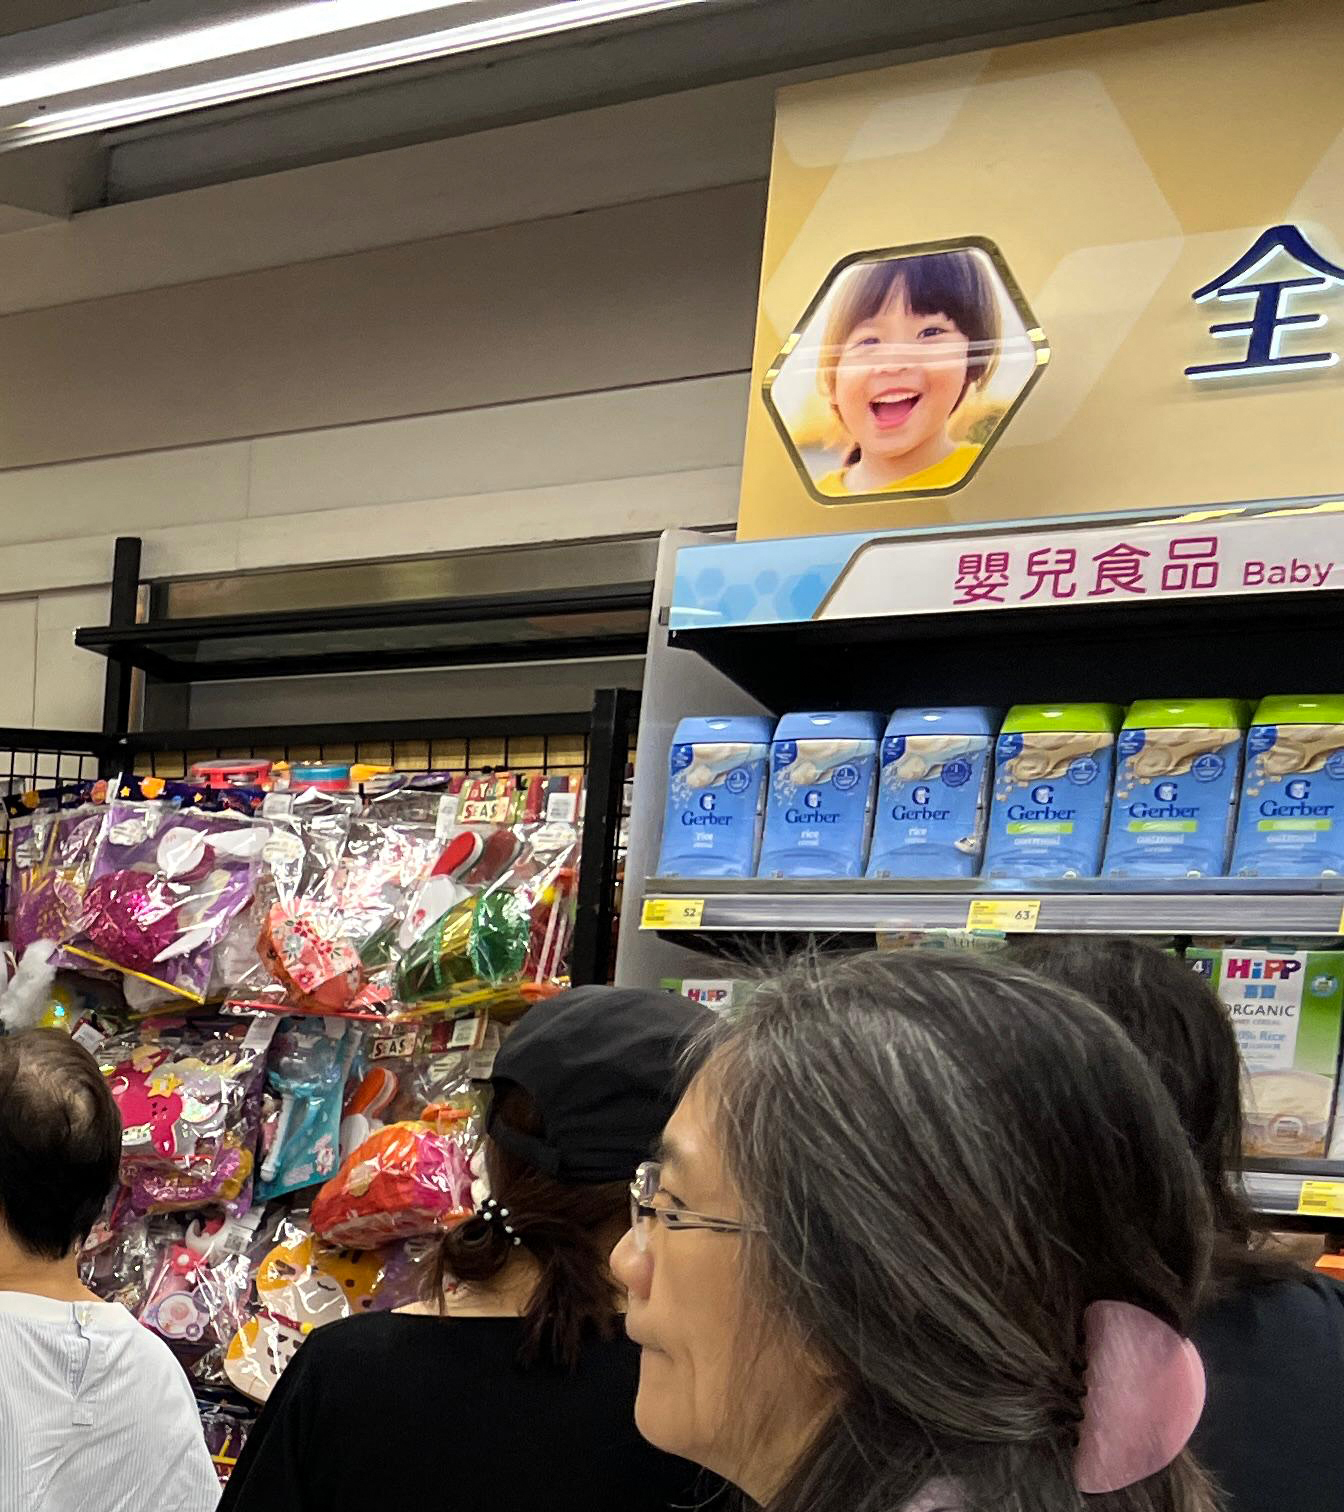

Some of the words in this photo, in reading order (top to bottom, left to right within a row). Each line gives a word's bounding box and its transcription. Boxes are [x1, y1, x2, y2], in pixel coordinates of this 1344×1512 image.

[953, 535, 1220, 606] 嬰兒食品
[1242, 557, 1334, 587] Baby
[785, 808, 840, 824] Gerber
[891, 806, 950, 822] Gerber
[1007, 804, 1076, 821] Gerber
[1129, 802, 1200, 818] Gerber
[1259, 799, 1335, 817] Gerber
[681, 811, 732, 827] Gerber
[1226, 958, 1302, 980] HiPP
